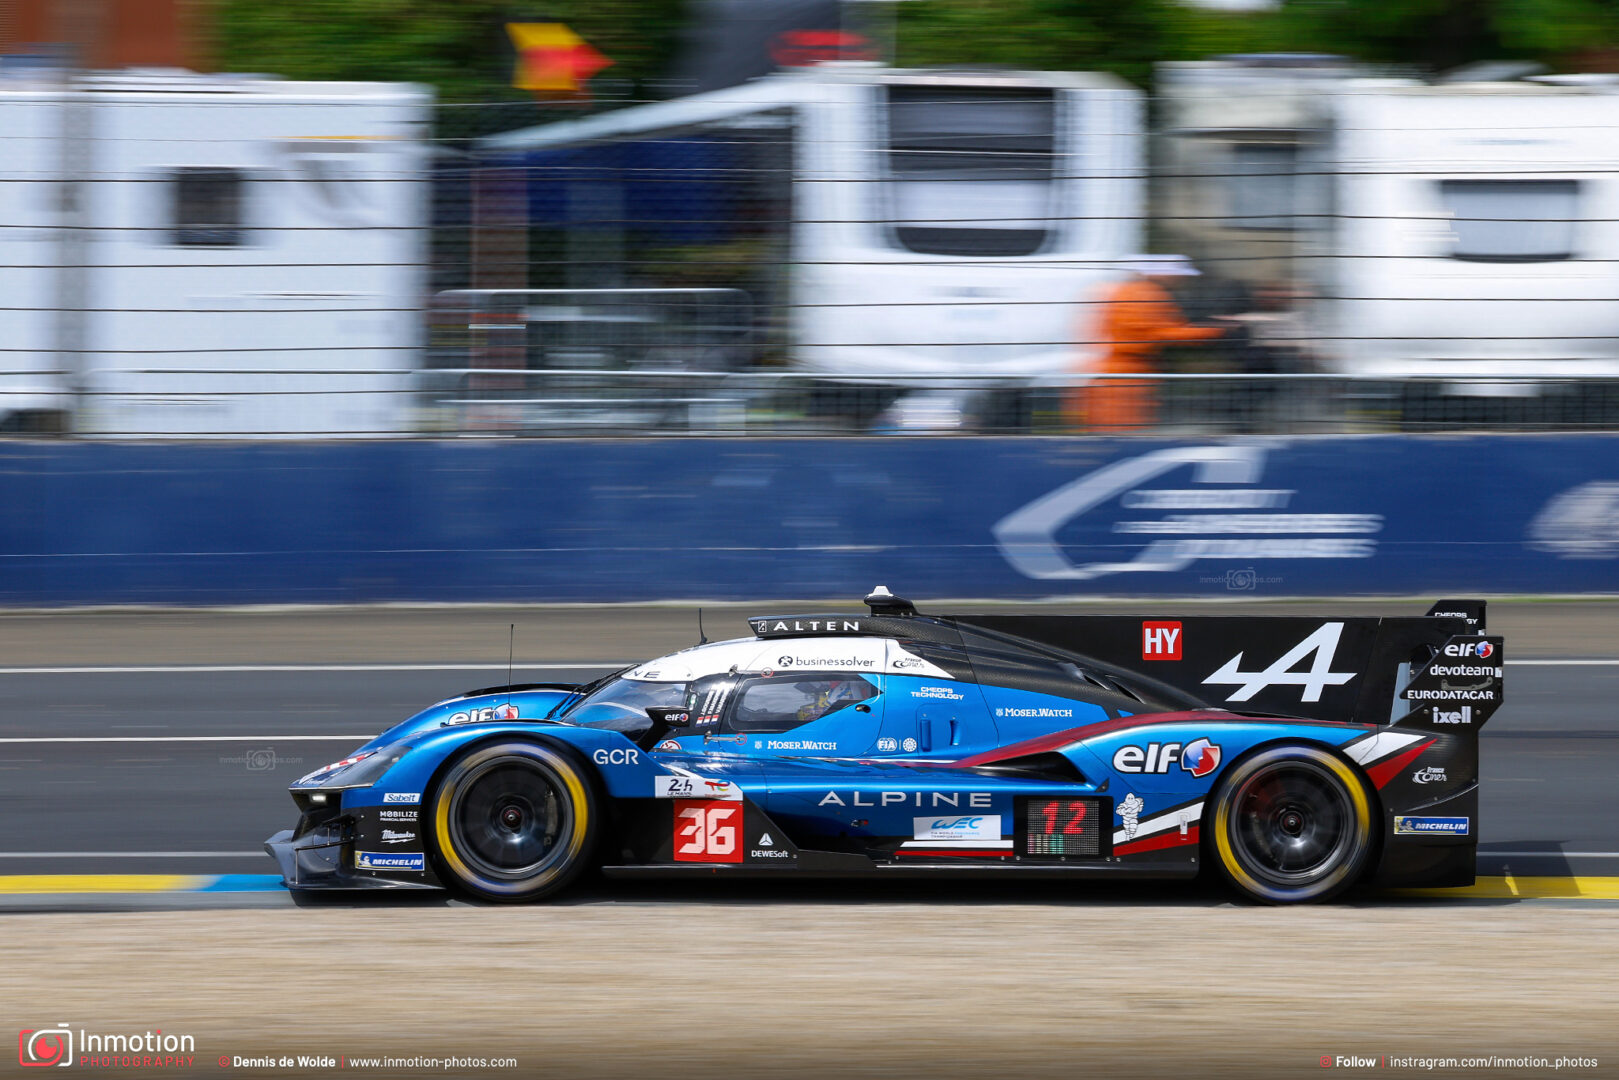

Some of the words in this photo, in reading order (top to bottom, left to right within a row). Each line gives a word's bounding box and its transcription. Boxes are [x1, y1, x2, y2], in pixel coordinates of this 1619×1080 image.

[773, 621, 860, 631] ALTEN
[1144, 628, 1180, 654] HY
[1444, 643, 1476, 657] elf
[796, 656, 876, 667] businessolver
[1430, 664, 1494, 676] devoteam
[910, 691, 965, 701] TECHNOLOGY
[1407, 690, 1494, 700] EURODATACAR
[448, 707, 492, 724] elf
[1432, 706, 1472, 724] ixell
[593, 749, 639, 765] GCR
[1112, 743, 1182, 774] elf
[817, 790, 993, 808] ALPINE
[931, 817, 984, 830] WEC
[1042, 801, 1087, 834] 12
[678, 808, 737, 855] 36
[751, 849, 789, 858] DEWESoft
